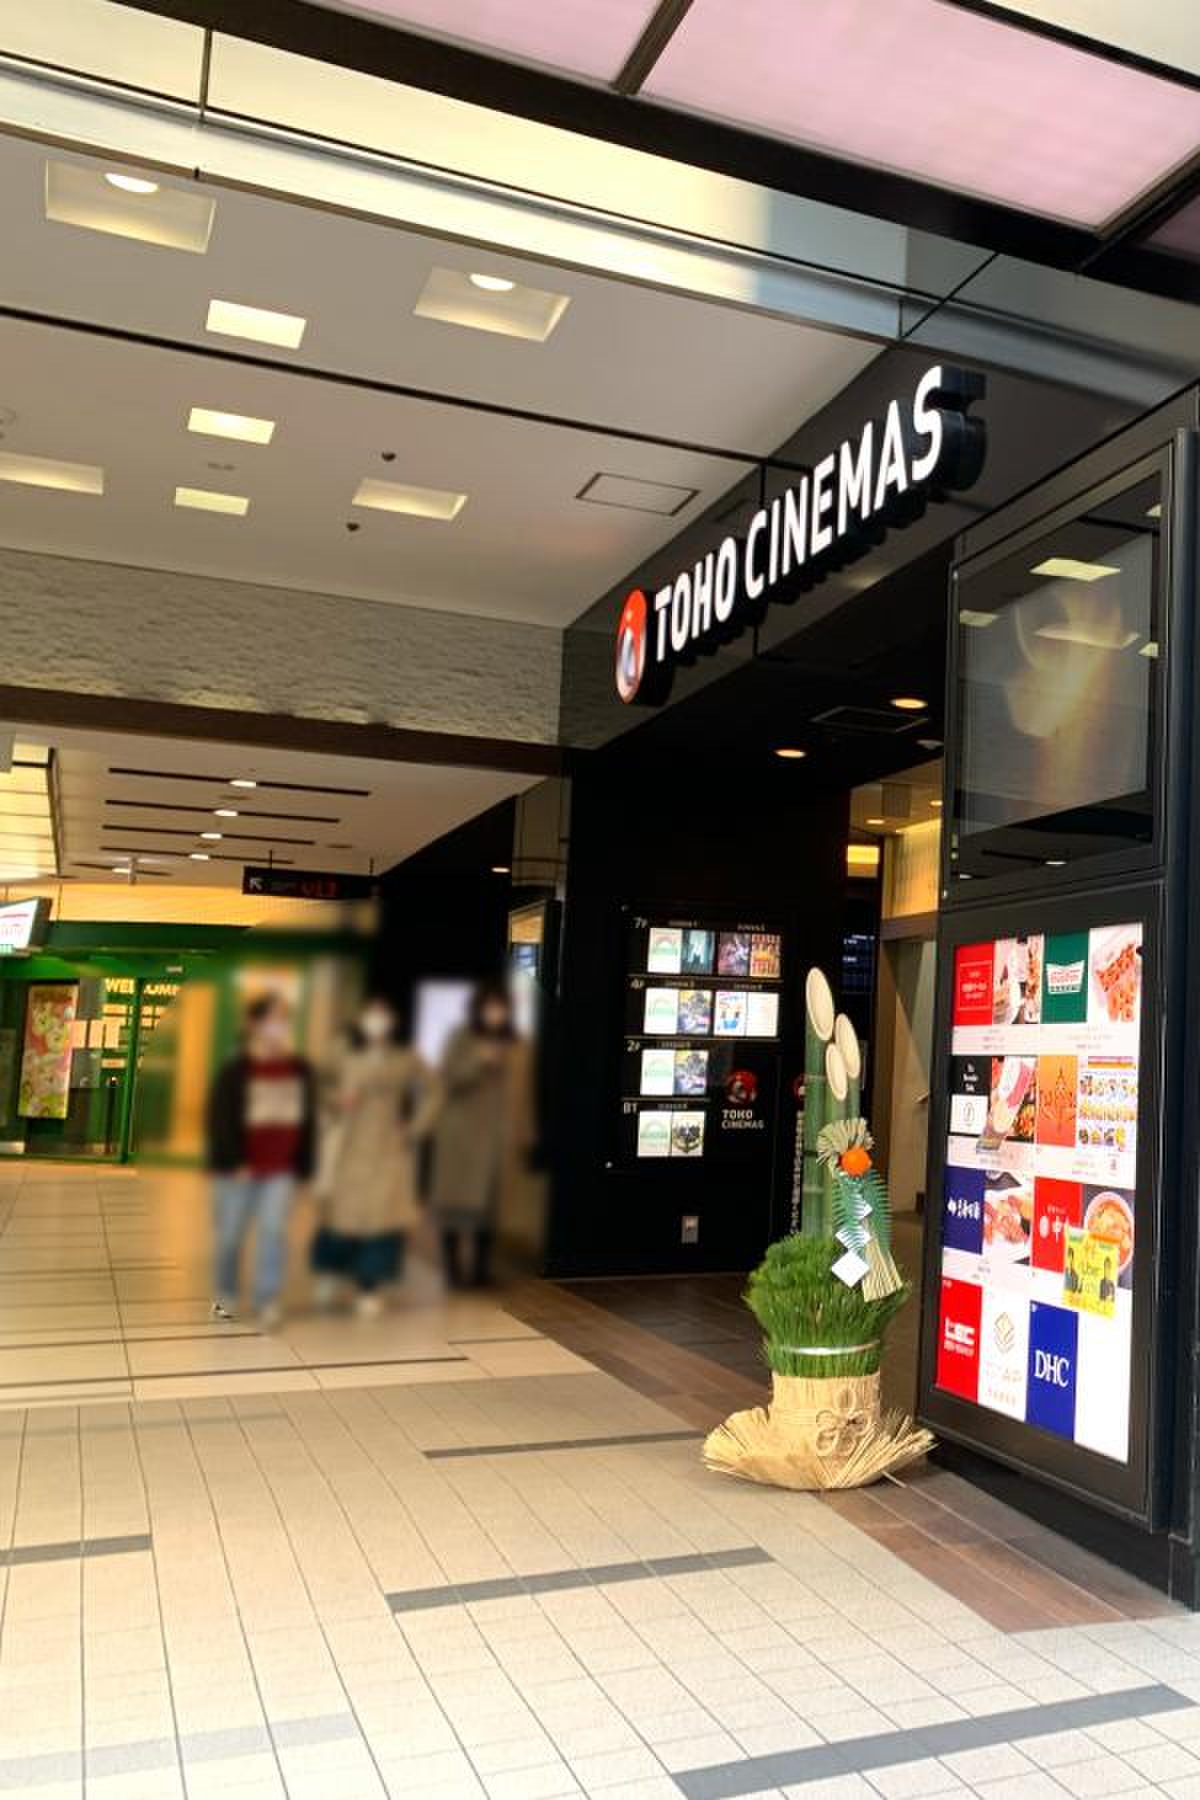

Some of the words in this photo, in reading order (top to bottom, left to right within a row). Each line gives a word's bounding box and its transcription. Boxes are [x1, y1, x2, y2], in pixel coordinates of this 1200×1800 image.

[655, 536, 737, 663] TOHO
[745, 365, 943, 600] CINEMAS
[721, 1109, 753, 1120] TOHO
[721, 1119, 765, 1130] CINEMAS
[1034, 1349, 1070, 1388] DHC
